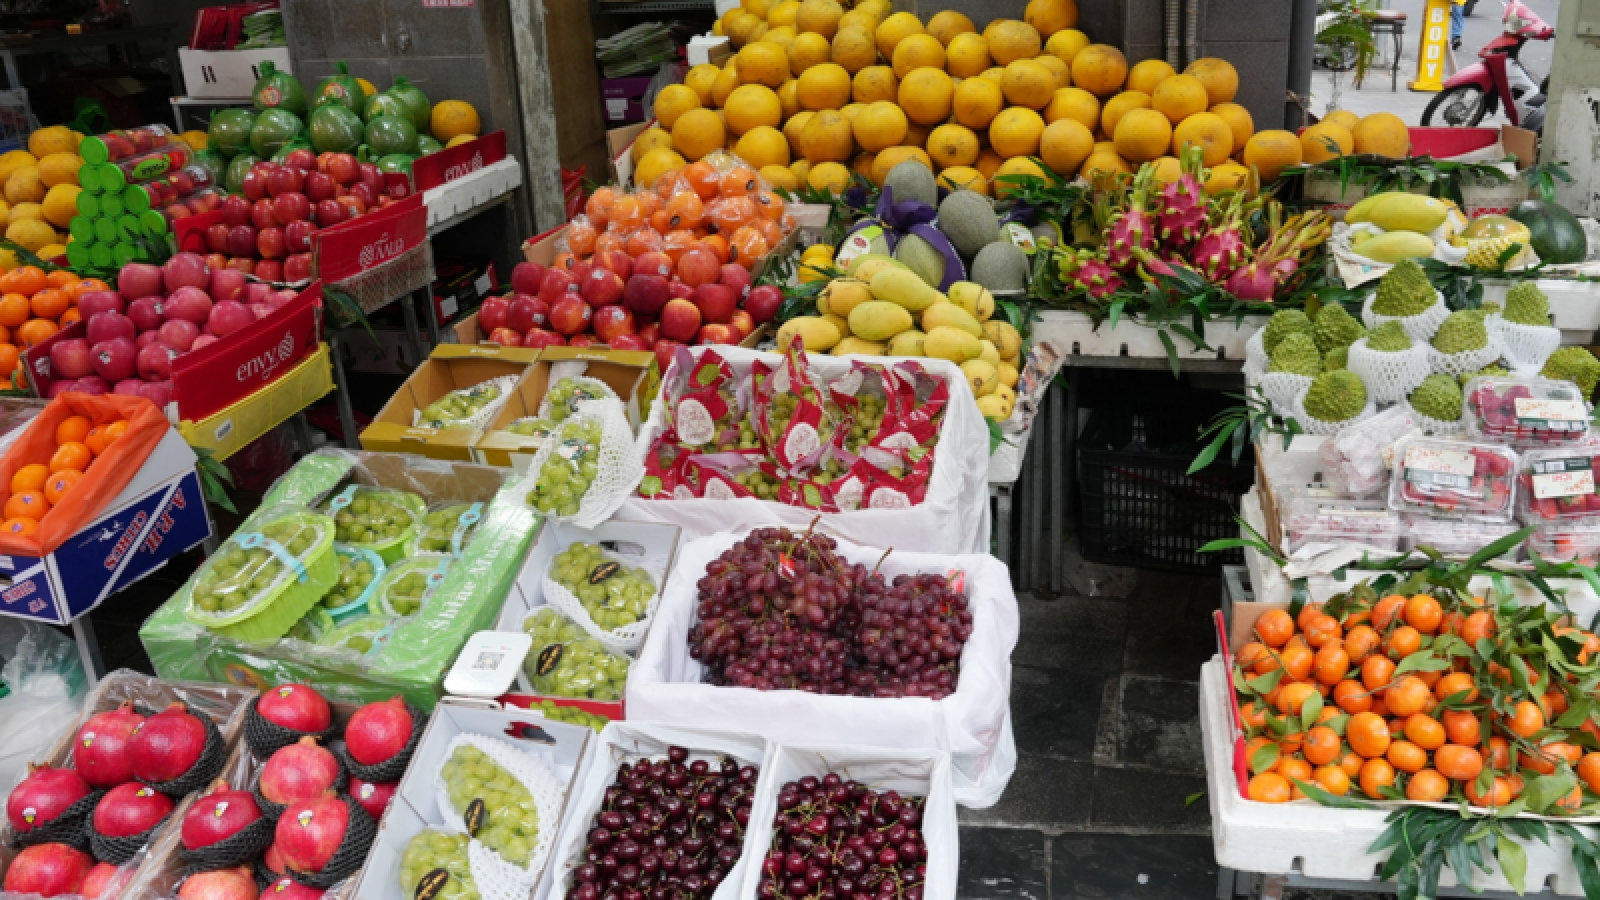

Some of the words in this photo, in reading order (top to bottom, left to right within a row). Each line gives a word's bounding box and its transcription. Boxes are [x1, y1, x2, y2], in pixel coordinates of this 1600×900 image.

[1426, 7, 1445, 78] BODY
[236, 346, 279, 382] envy
[103, 510, 149, 571] CITRUS
